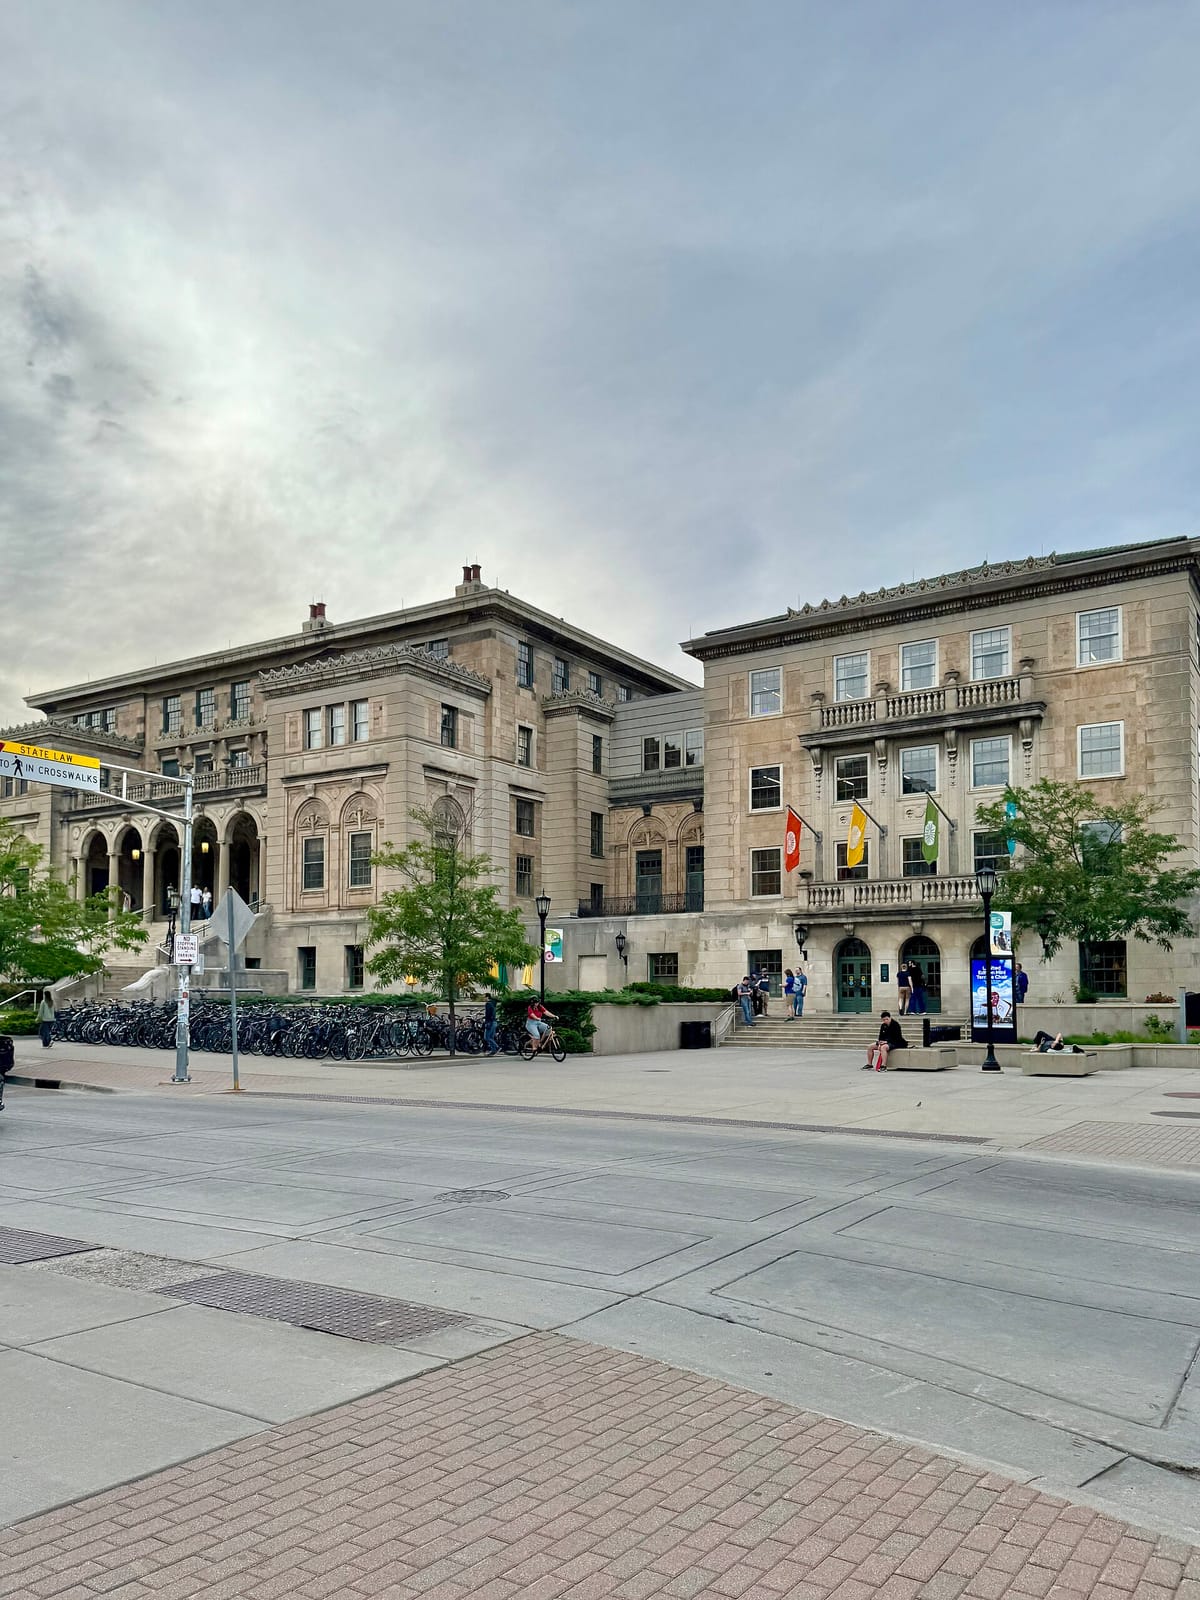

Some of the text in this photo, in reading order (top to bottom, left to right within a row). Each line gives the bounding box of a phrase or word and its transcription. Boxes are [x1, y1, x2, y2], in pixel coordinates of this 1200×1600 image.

[20, 746, 73, 762] STATE LAW
[0, 759, 98, 784] TO IN CROSSWALKS
